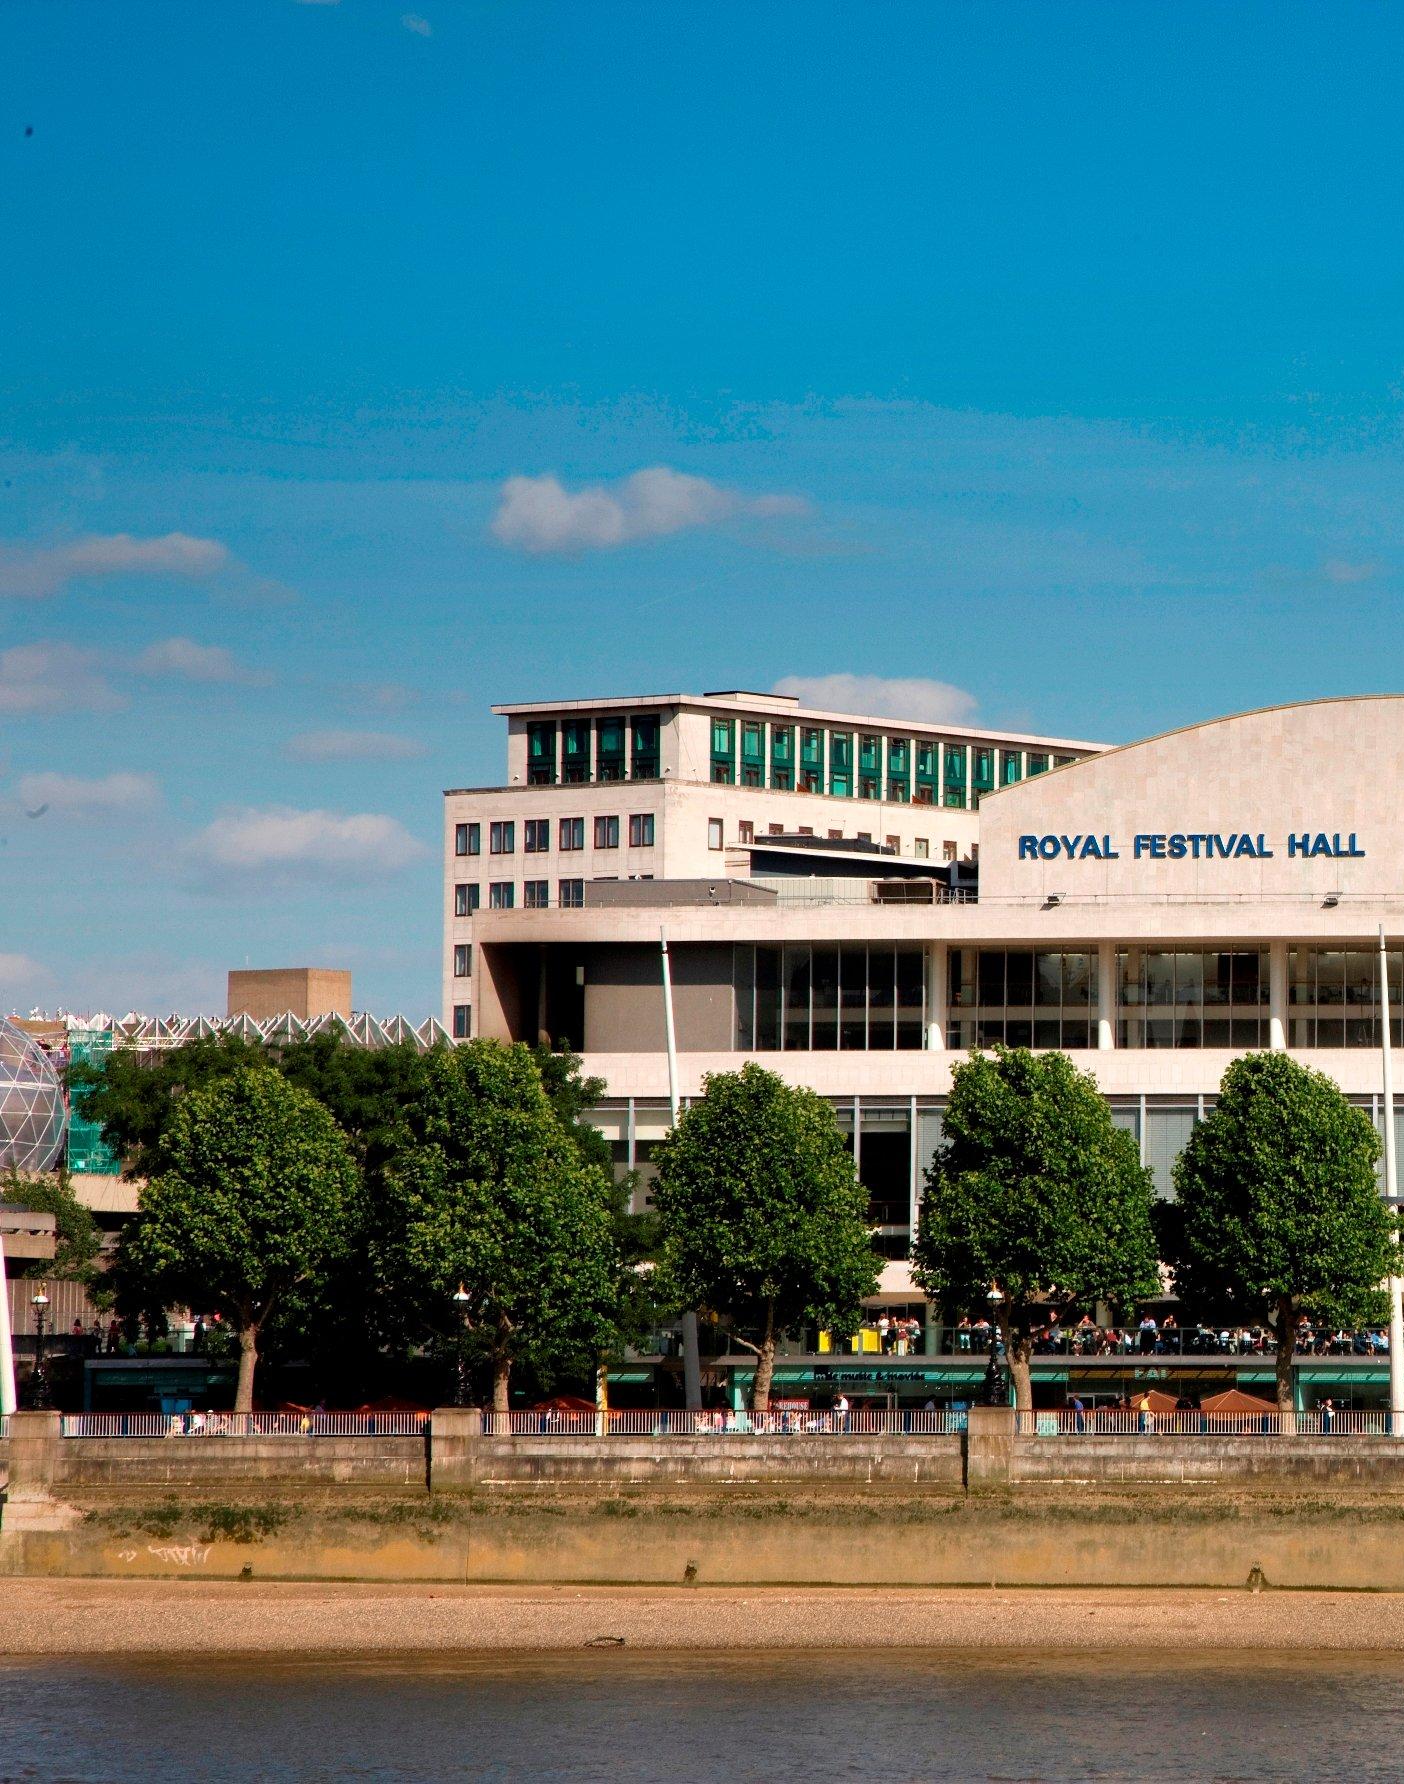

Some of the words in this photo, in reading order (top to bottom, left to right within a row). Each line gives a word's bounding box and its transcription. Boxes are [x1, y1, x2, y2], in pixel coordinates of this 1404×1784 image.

[1018, 835, 1119, 860] ROYAL
[1133, 834, 1274, 859] FESTIVAL
[1287, 833, 1366, 858] HALL
[841, 1371, 872, 1381] music
[887, 1371, 925, 1381] movies
